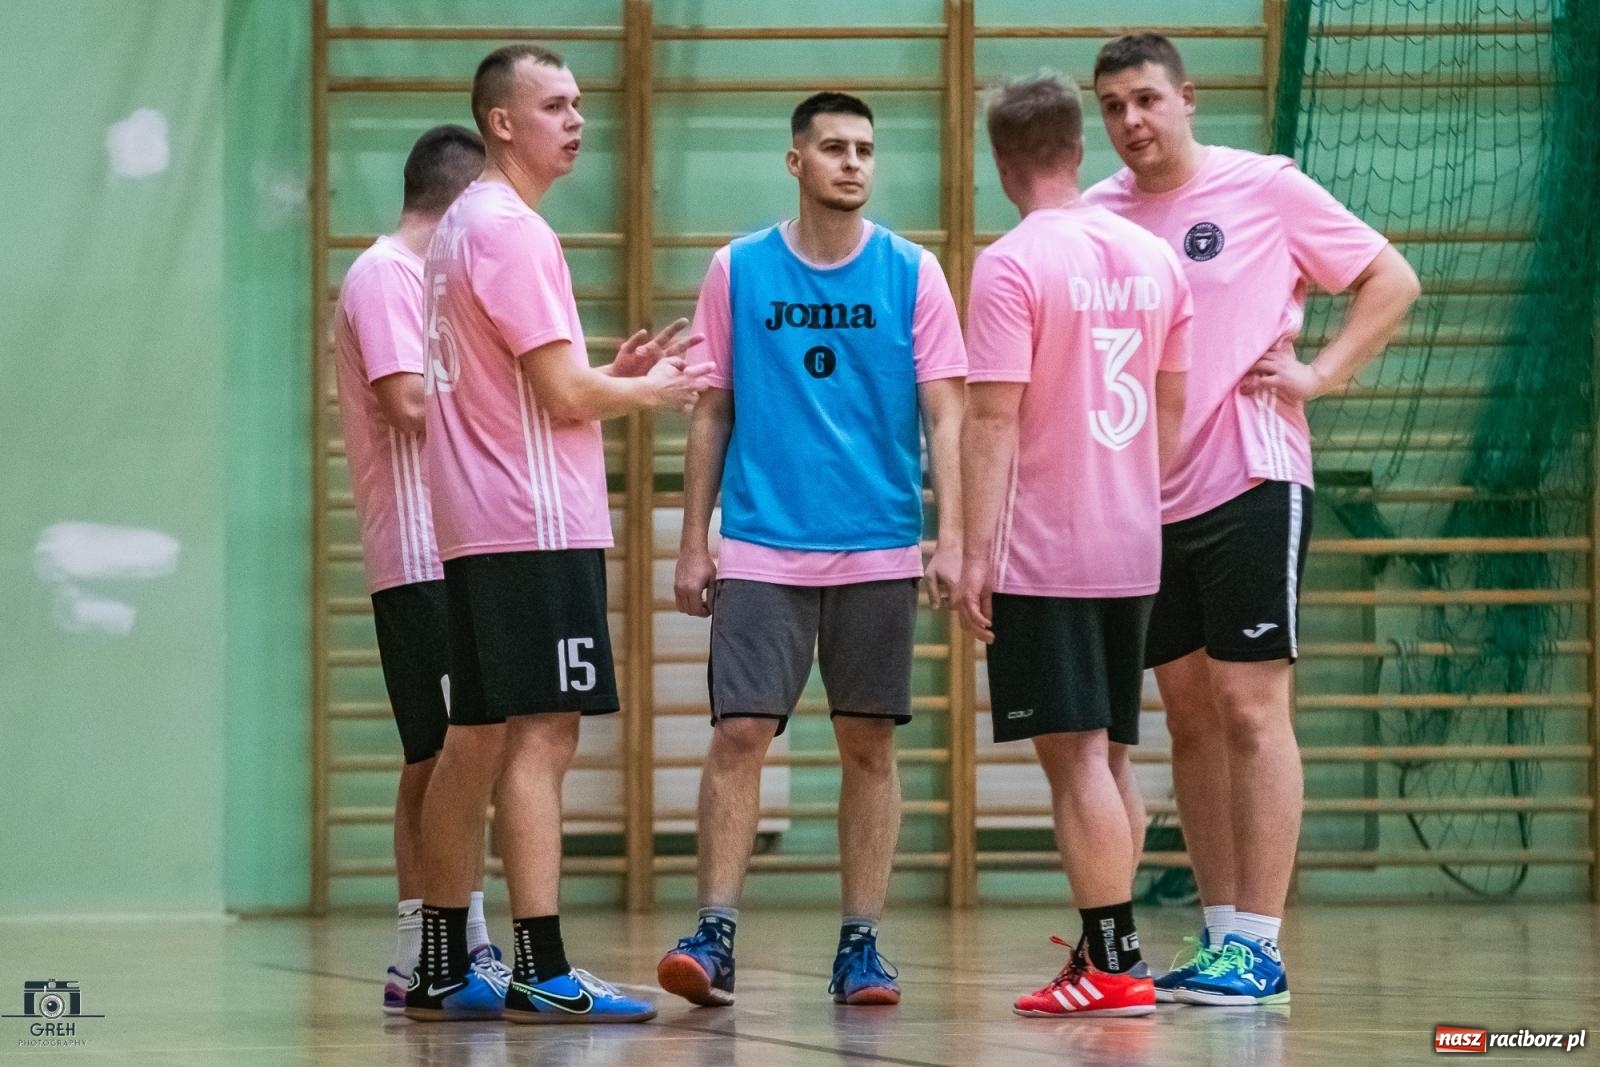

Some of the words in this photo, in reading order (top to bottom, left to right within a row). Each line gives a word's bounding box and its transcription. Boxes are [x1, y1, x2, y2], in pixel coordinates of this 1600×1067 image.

[1071, 276, 1161, 312] DAWID
[814, 352, 825, 373] 6
[1088, 327, 1149, 451] 3
[557, 637, 597, 692] 15
